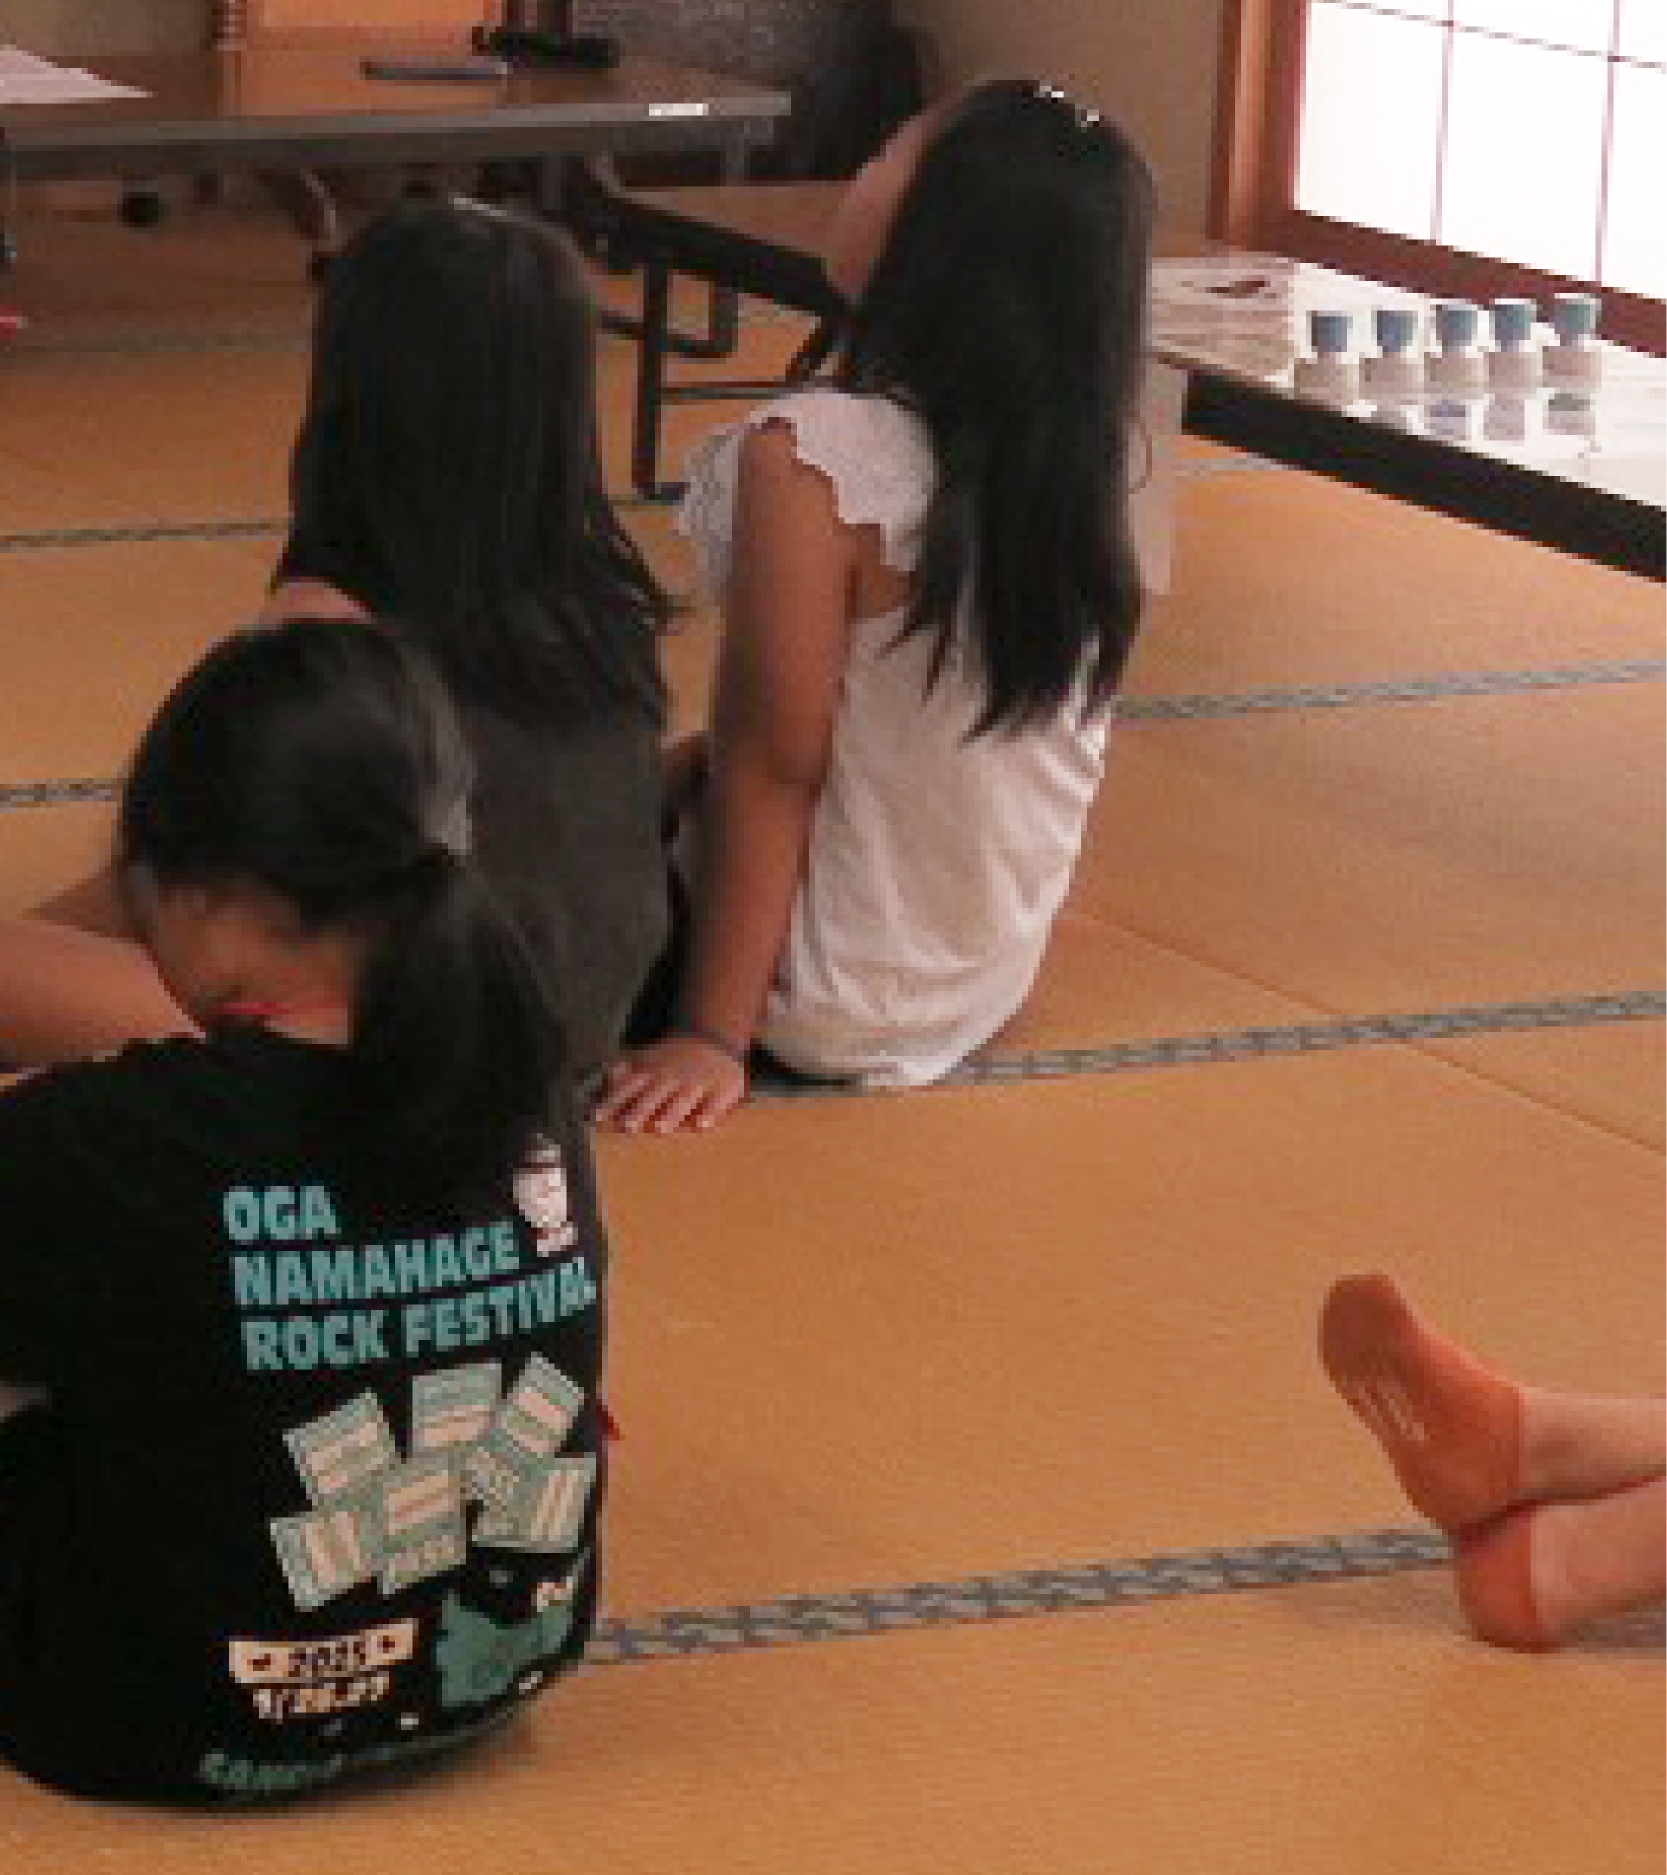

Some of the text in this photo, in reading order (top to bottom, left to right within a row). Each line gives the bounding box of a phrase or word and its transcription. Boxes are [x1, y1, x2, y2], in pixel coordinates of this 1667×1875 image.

[223, 1185, 338, 1240] OGA
[234, 1222, 520, 1306] NAMAHAGE
[241, 1308, 390, 1371] ROCK
